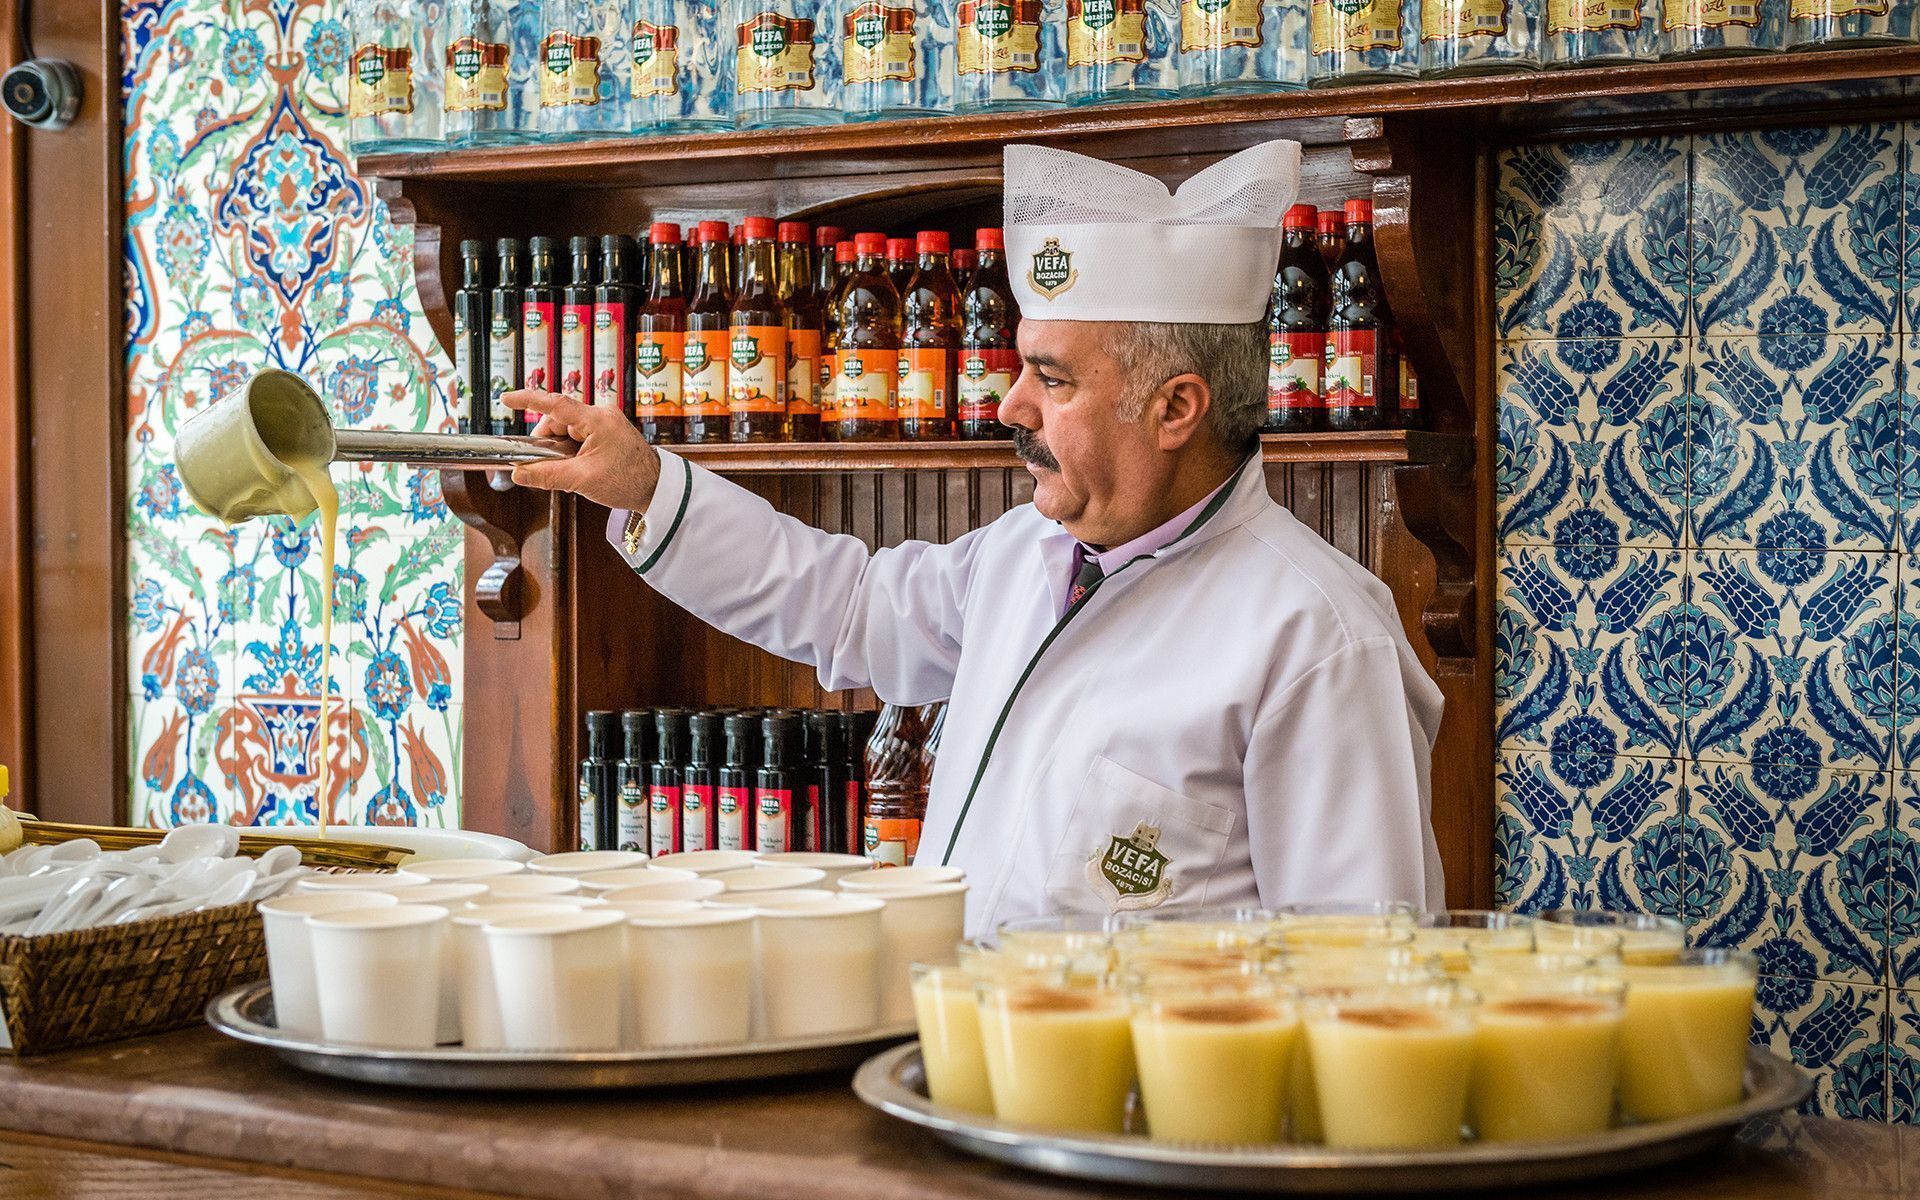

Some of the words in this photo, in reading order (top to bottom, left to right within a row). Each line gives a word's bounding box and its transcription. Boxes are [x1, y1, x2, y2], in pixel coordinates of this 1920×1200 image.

[1084, 0, 1113, 13] VEFA
[978, 9, 1009, 22] VEFA
[857, 20, 883, 33] VEFA
[754, 30, 783, 43] VEFA
[634, 38, 652, 50] VEFA
[455, 53, 480, 65] VEFA
[548, 48, 571, 60] VEFA
[359, 59, 383, 72] VEFA
[1035, 255, 1068, 271] VEFA
[1035, 271, 1068, 280] BOZACISI
[638, 346, 660, 357] VEFA
[684, 345, 704, 356] VEFA
[732, 340, 755, 351] VEFA
[844, 361, 862, 369] VEFA
[966, 361, 984, 369] VEFA
[1111, 841, 1160, 878] VEFA
[1104, 860, 1153, 888] BOZACISI
